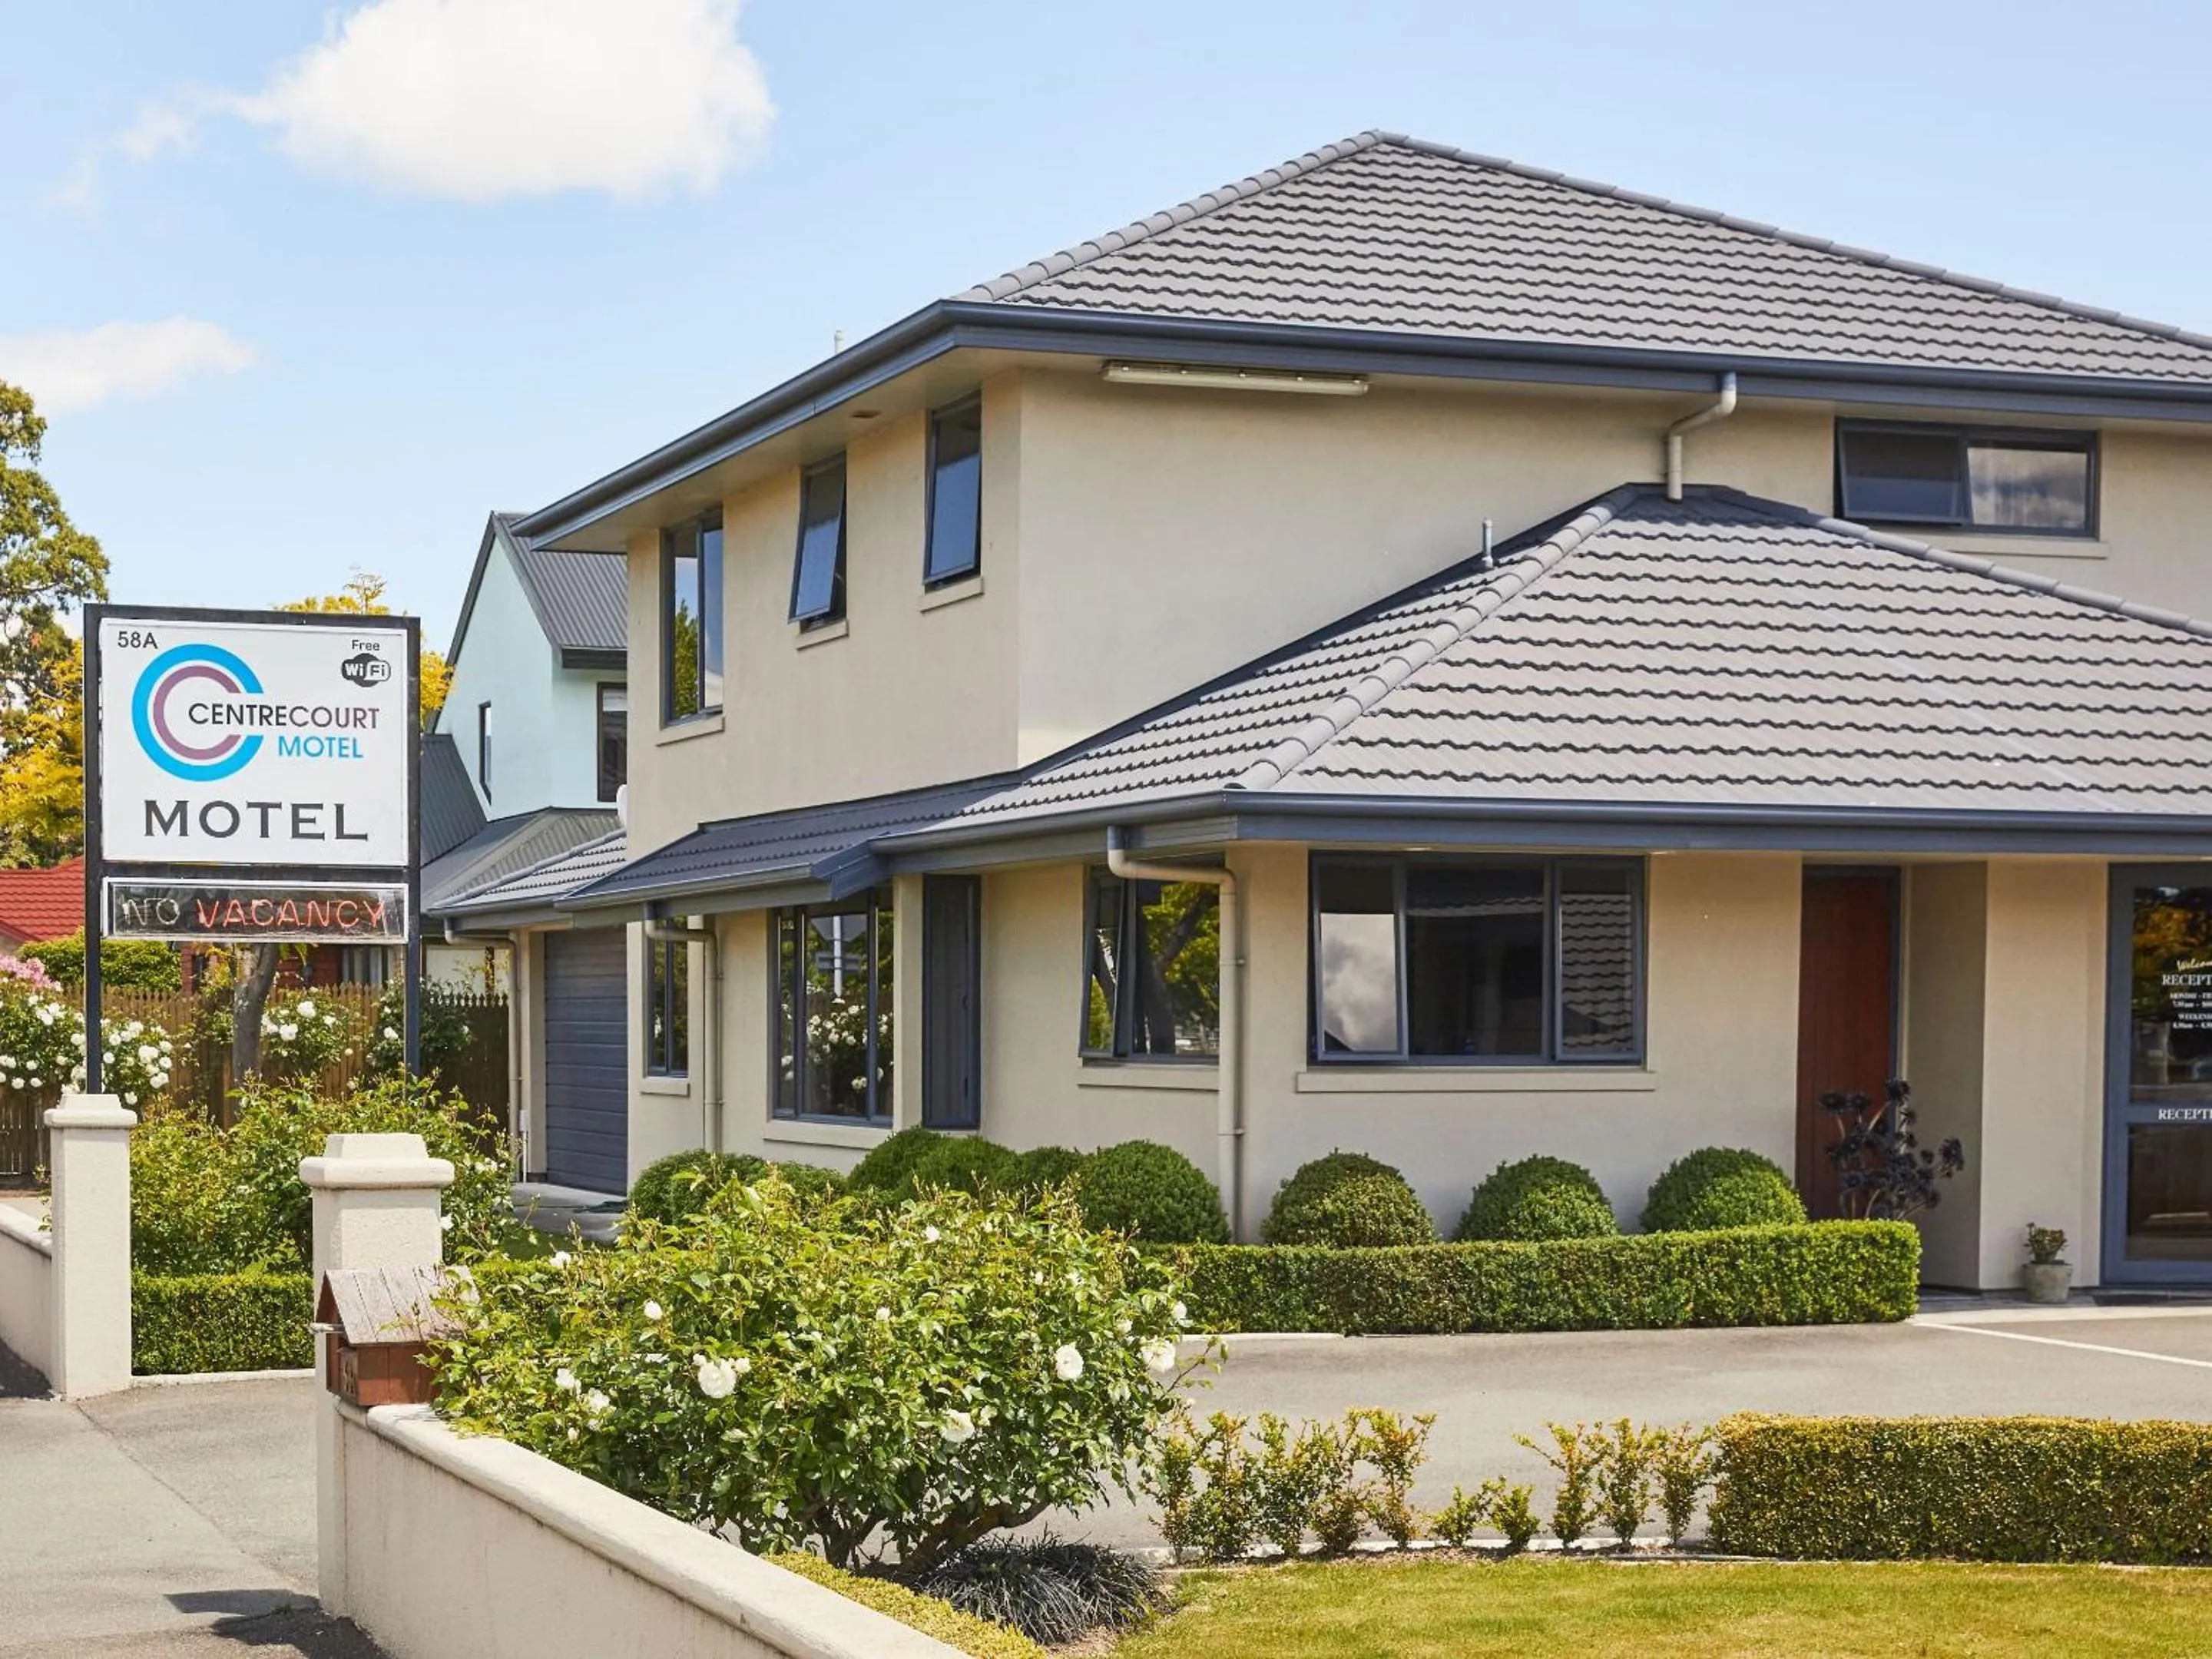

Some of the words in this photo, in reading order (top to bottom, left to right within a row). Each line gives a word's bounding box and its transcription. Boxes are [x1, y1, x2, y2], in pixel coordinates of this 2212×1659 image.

[117, 631, 158, 649] 58A
[352, 639, 380, 651] Free
[188, 703, 380, 729] CENTRECOURT
[277, 736, 364, 759] MOTEL
[144, 800, 369, 842] MOTEL
[123, 897, 180, 926] NO
[197, 898, 386, 929] VACANCY
